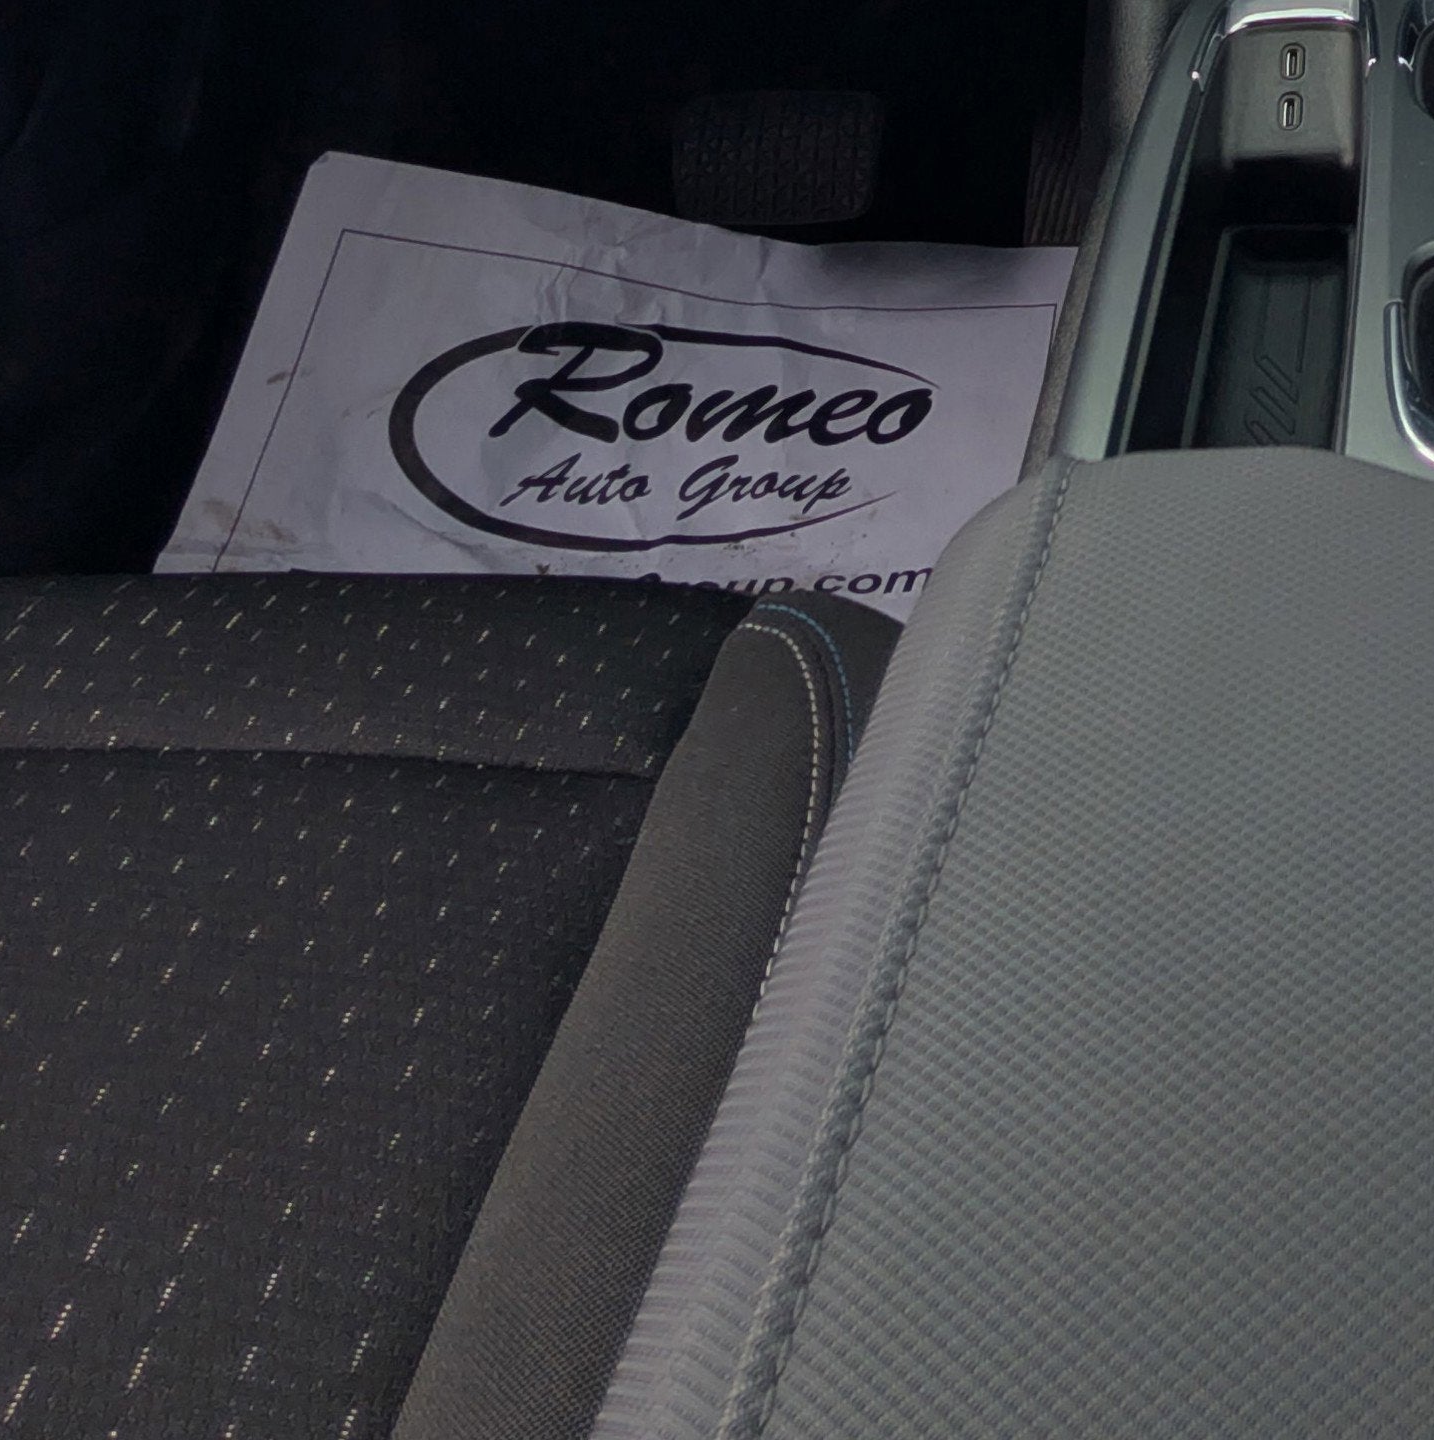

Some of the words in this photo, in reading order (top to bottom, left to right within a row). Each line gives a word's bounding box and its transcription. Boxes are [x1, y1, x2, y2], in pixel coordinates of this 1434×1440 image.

[489, 321, 939, 447] Romeo
[499, 453, 652, 508] Auto
[677, 454, 853, 520] Group
